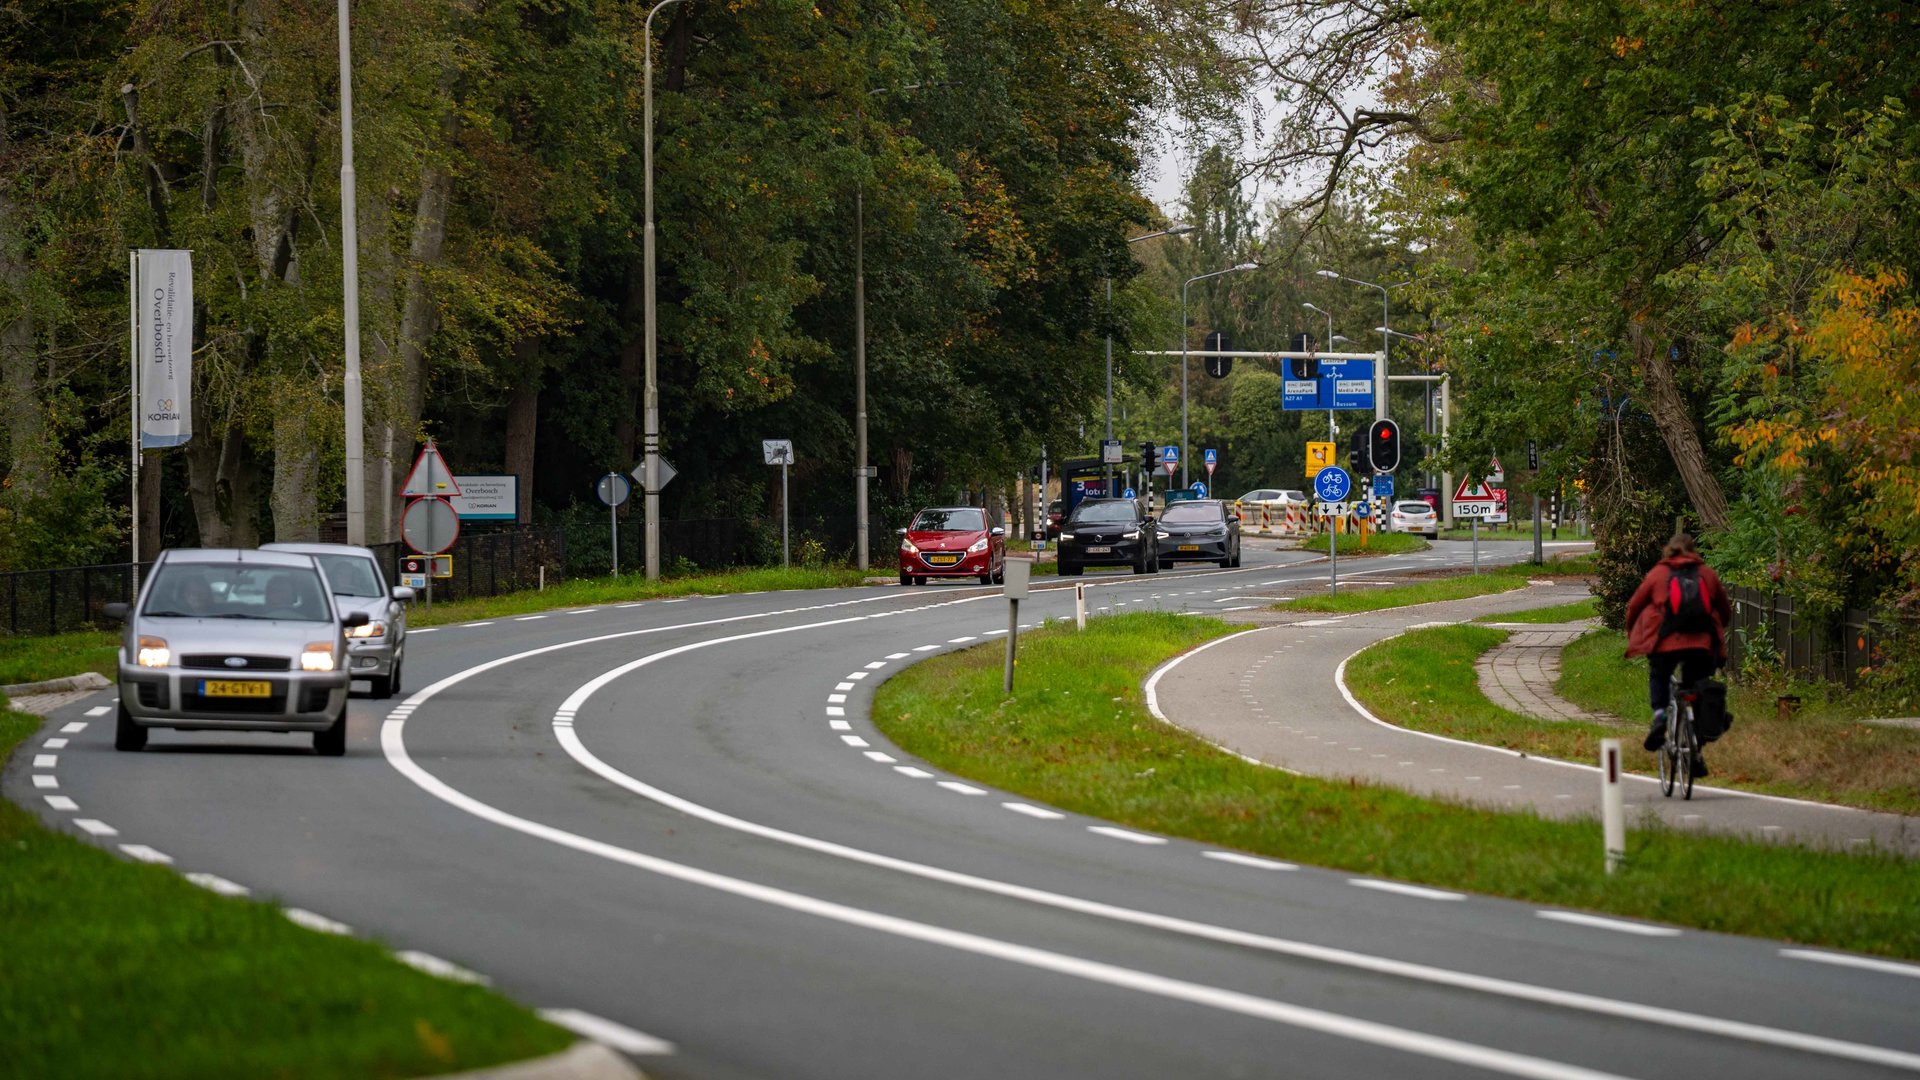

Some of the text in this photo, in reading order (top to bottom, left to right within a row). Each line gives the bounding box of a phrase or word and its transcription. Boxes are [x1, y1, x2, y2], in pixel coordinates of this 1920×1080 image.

[166, 272, 176, 320] Revalidatie-
[153, 288, 166, 363] Overbosch
[166, 322, 173, 332] en
[1076, 481, 1085, 491] 3
[210, 682, 266, 694] 24-GTV-1
